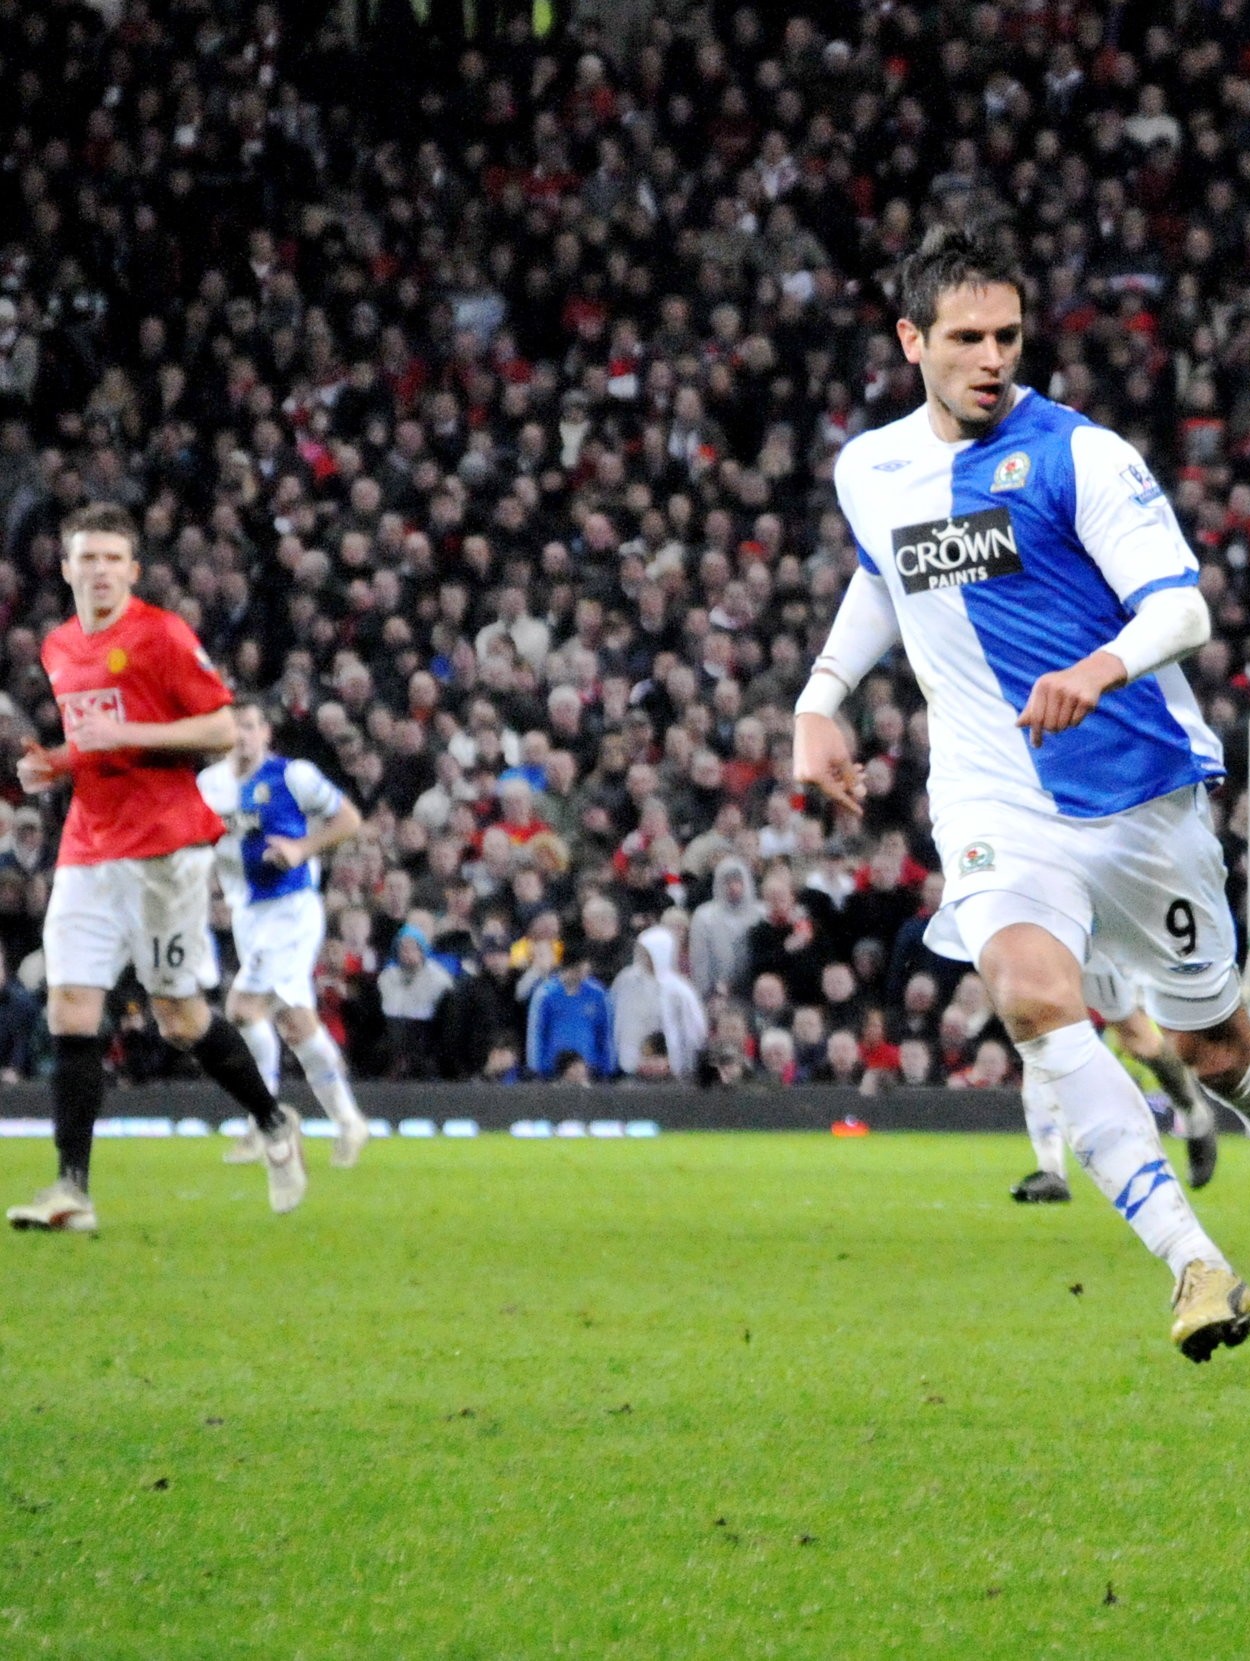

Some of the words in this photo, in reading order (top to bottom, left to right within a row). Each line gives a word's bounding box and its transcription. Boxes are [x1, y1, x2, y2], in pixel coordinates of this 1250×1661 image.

[896, 525, 1018, 577] CROWN
[928, 566, 989, 590] PAINTS
[1165, 898, 1197, 956] 9
[151, 933, 185, 969] 16
